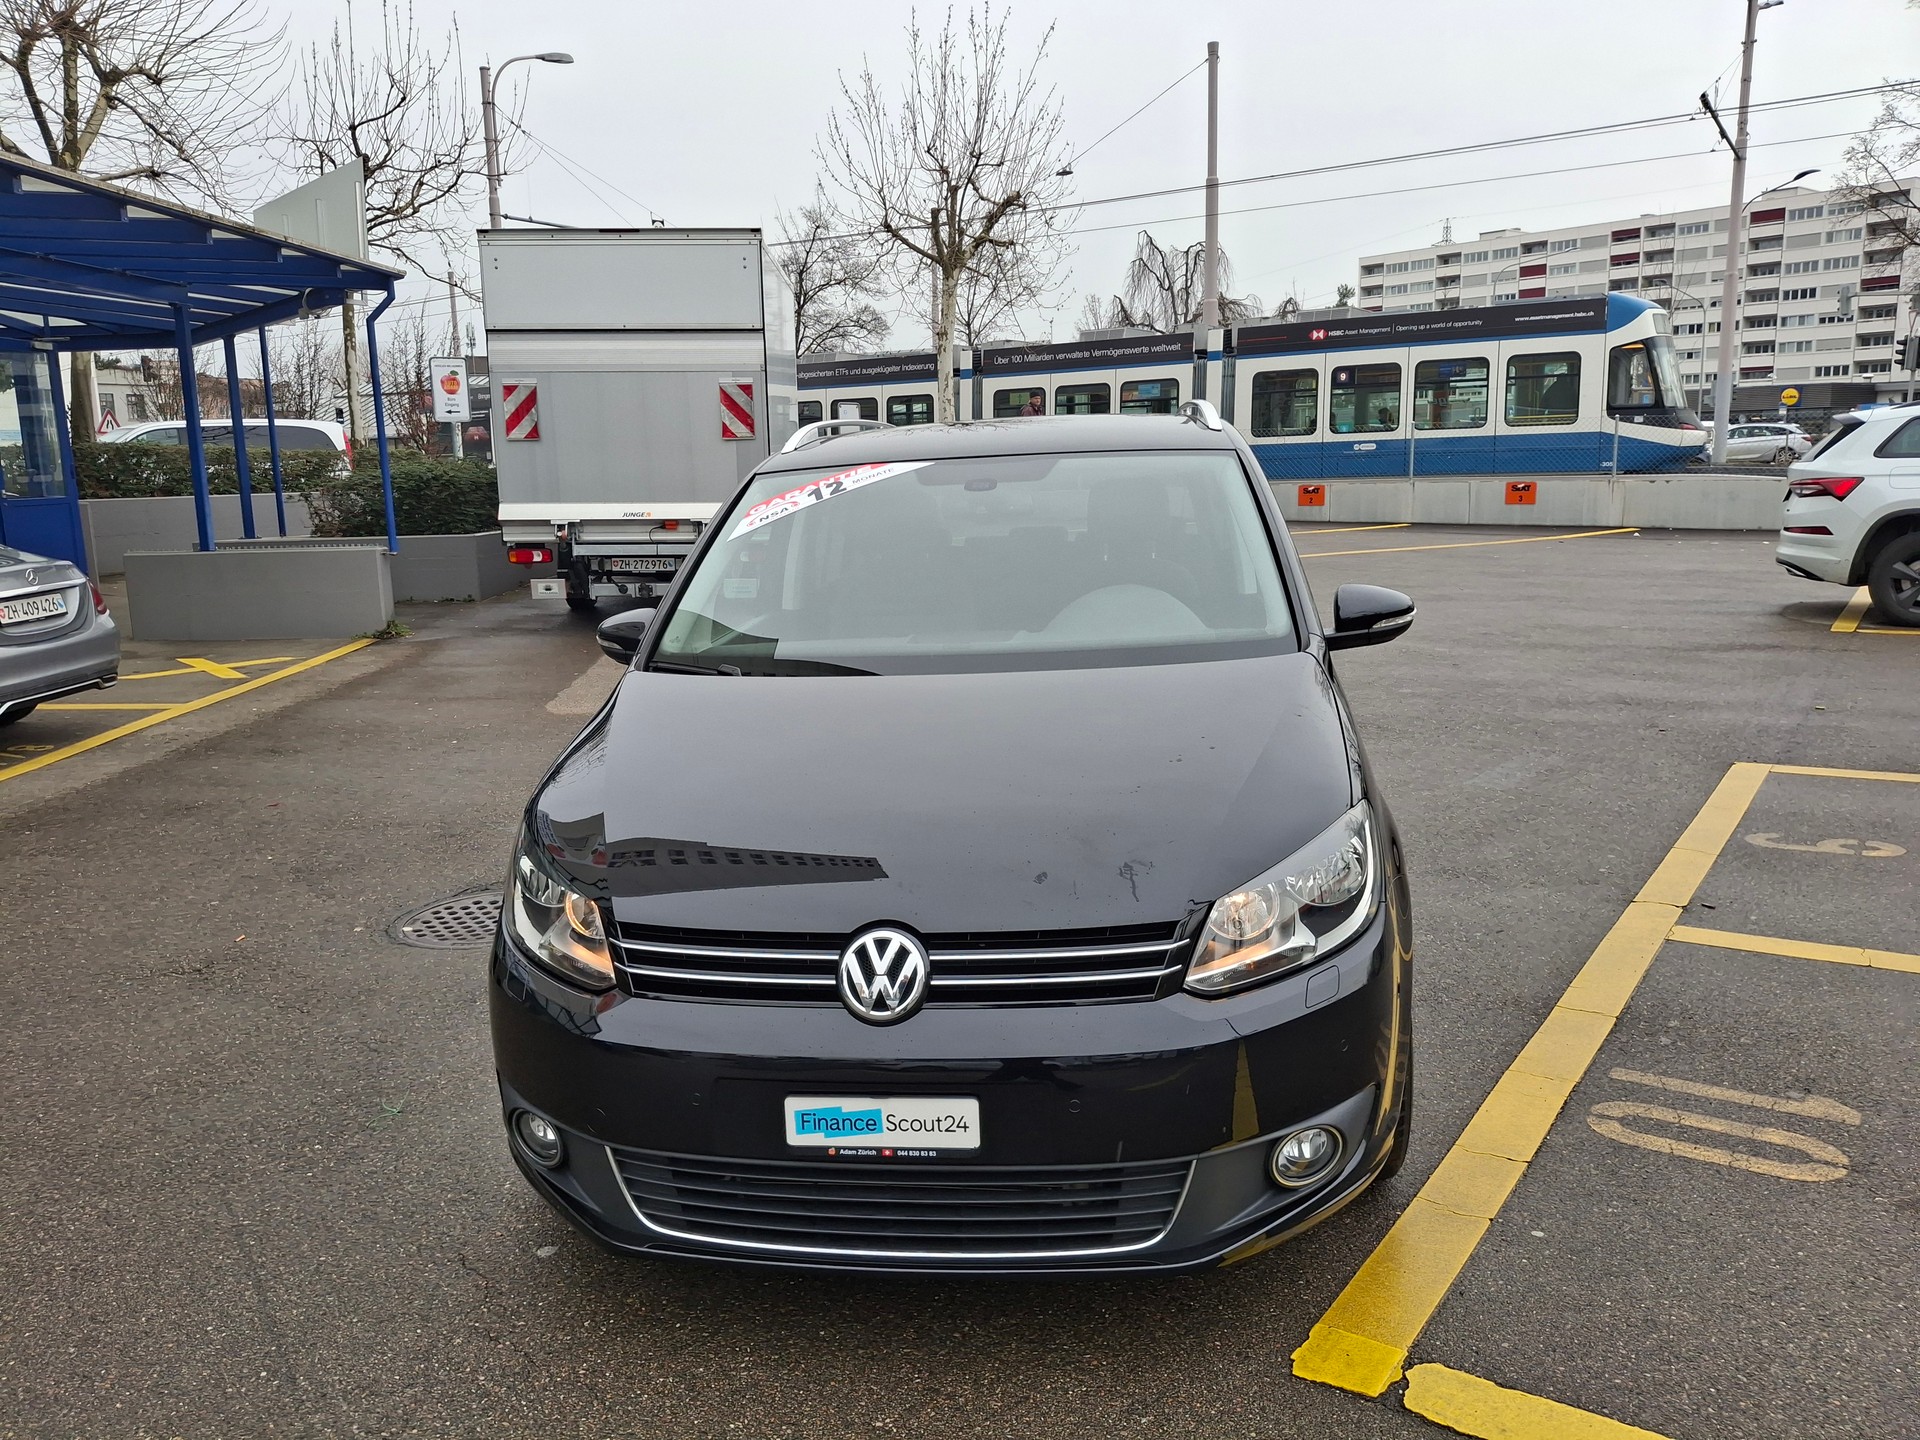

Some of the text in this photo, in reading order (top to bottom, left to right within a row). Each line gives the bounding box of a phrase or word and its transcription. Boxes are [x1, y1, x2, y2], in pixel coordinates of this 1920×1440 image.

[1328, 329, 1345, 337] HSBC
[1359, 326, 1391, 334] Management
[1453, 319, 1484, 327] opportunity
[993, 343, 1182, 365] Über 100 Milliarden verwaltete Vermögenswerte weltweit
[835, 367, 849, 376] ETFs
[849, 367, 861, 376] und
[861, 364, 901, 377] ausgeklügelter
[901, 362, 935, 373] Indexierung
[1340, 372, 1347, 381] 9
[852, 467, 895, 484] MONATE
[808, 480, 847, 501] 12
[1743, 831, 1908, 858] 9
[801, 1112, 970, 1133] Finance Scout24
[1585, 1066, 1863, 1183] 10
[857, 1148, 877, 1156] Zürich
